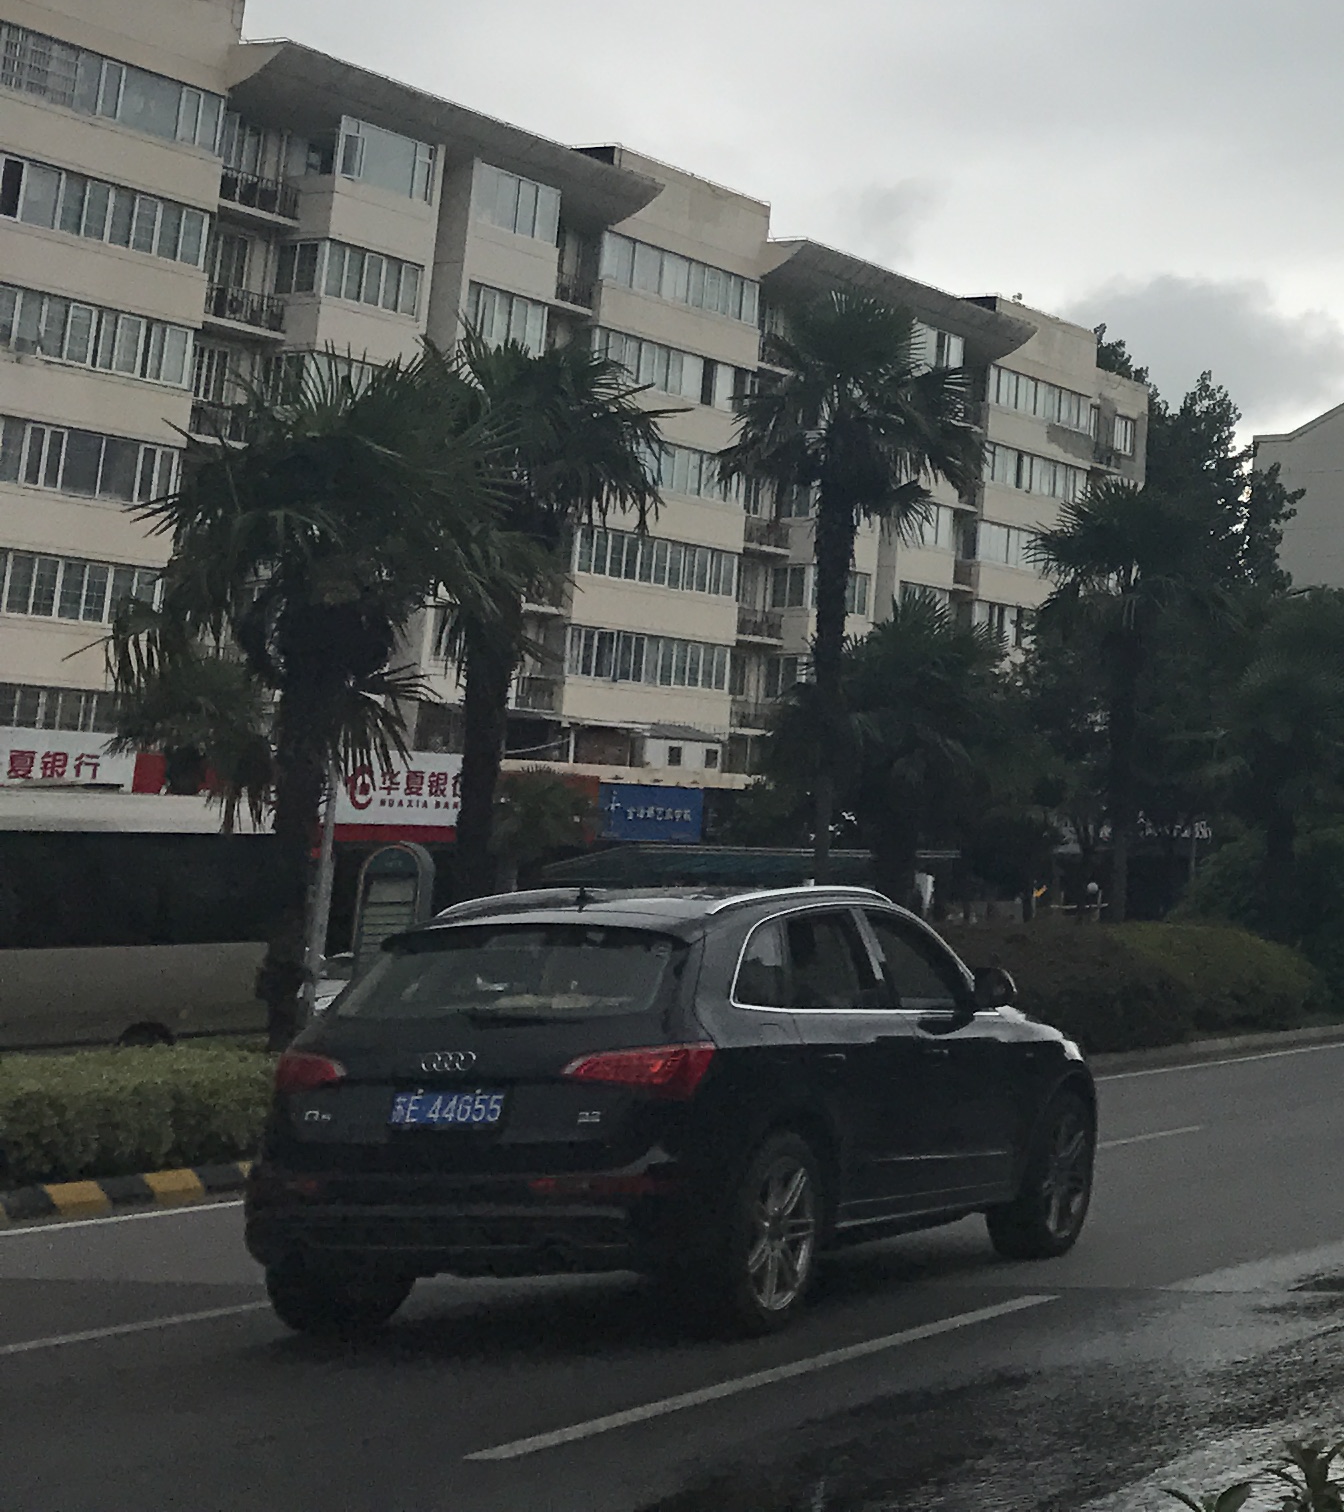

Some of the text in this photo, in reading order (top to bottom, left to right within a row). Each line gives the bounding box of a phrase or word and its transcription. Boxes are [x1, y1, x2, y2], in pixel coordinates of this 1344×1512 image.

[7, 749, 101, 780] 夏银行
[379, 798, 428, 809] HUAXIA
